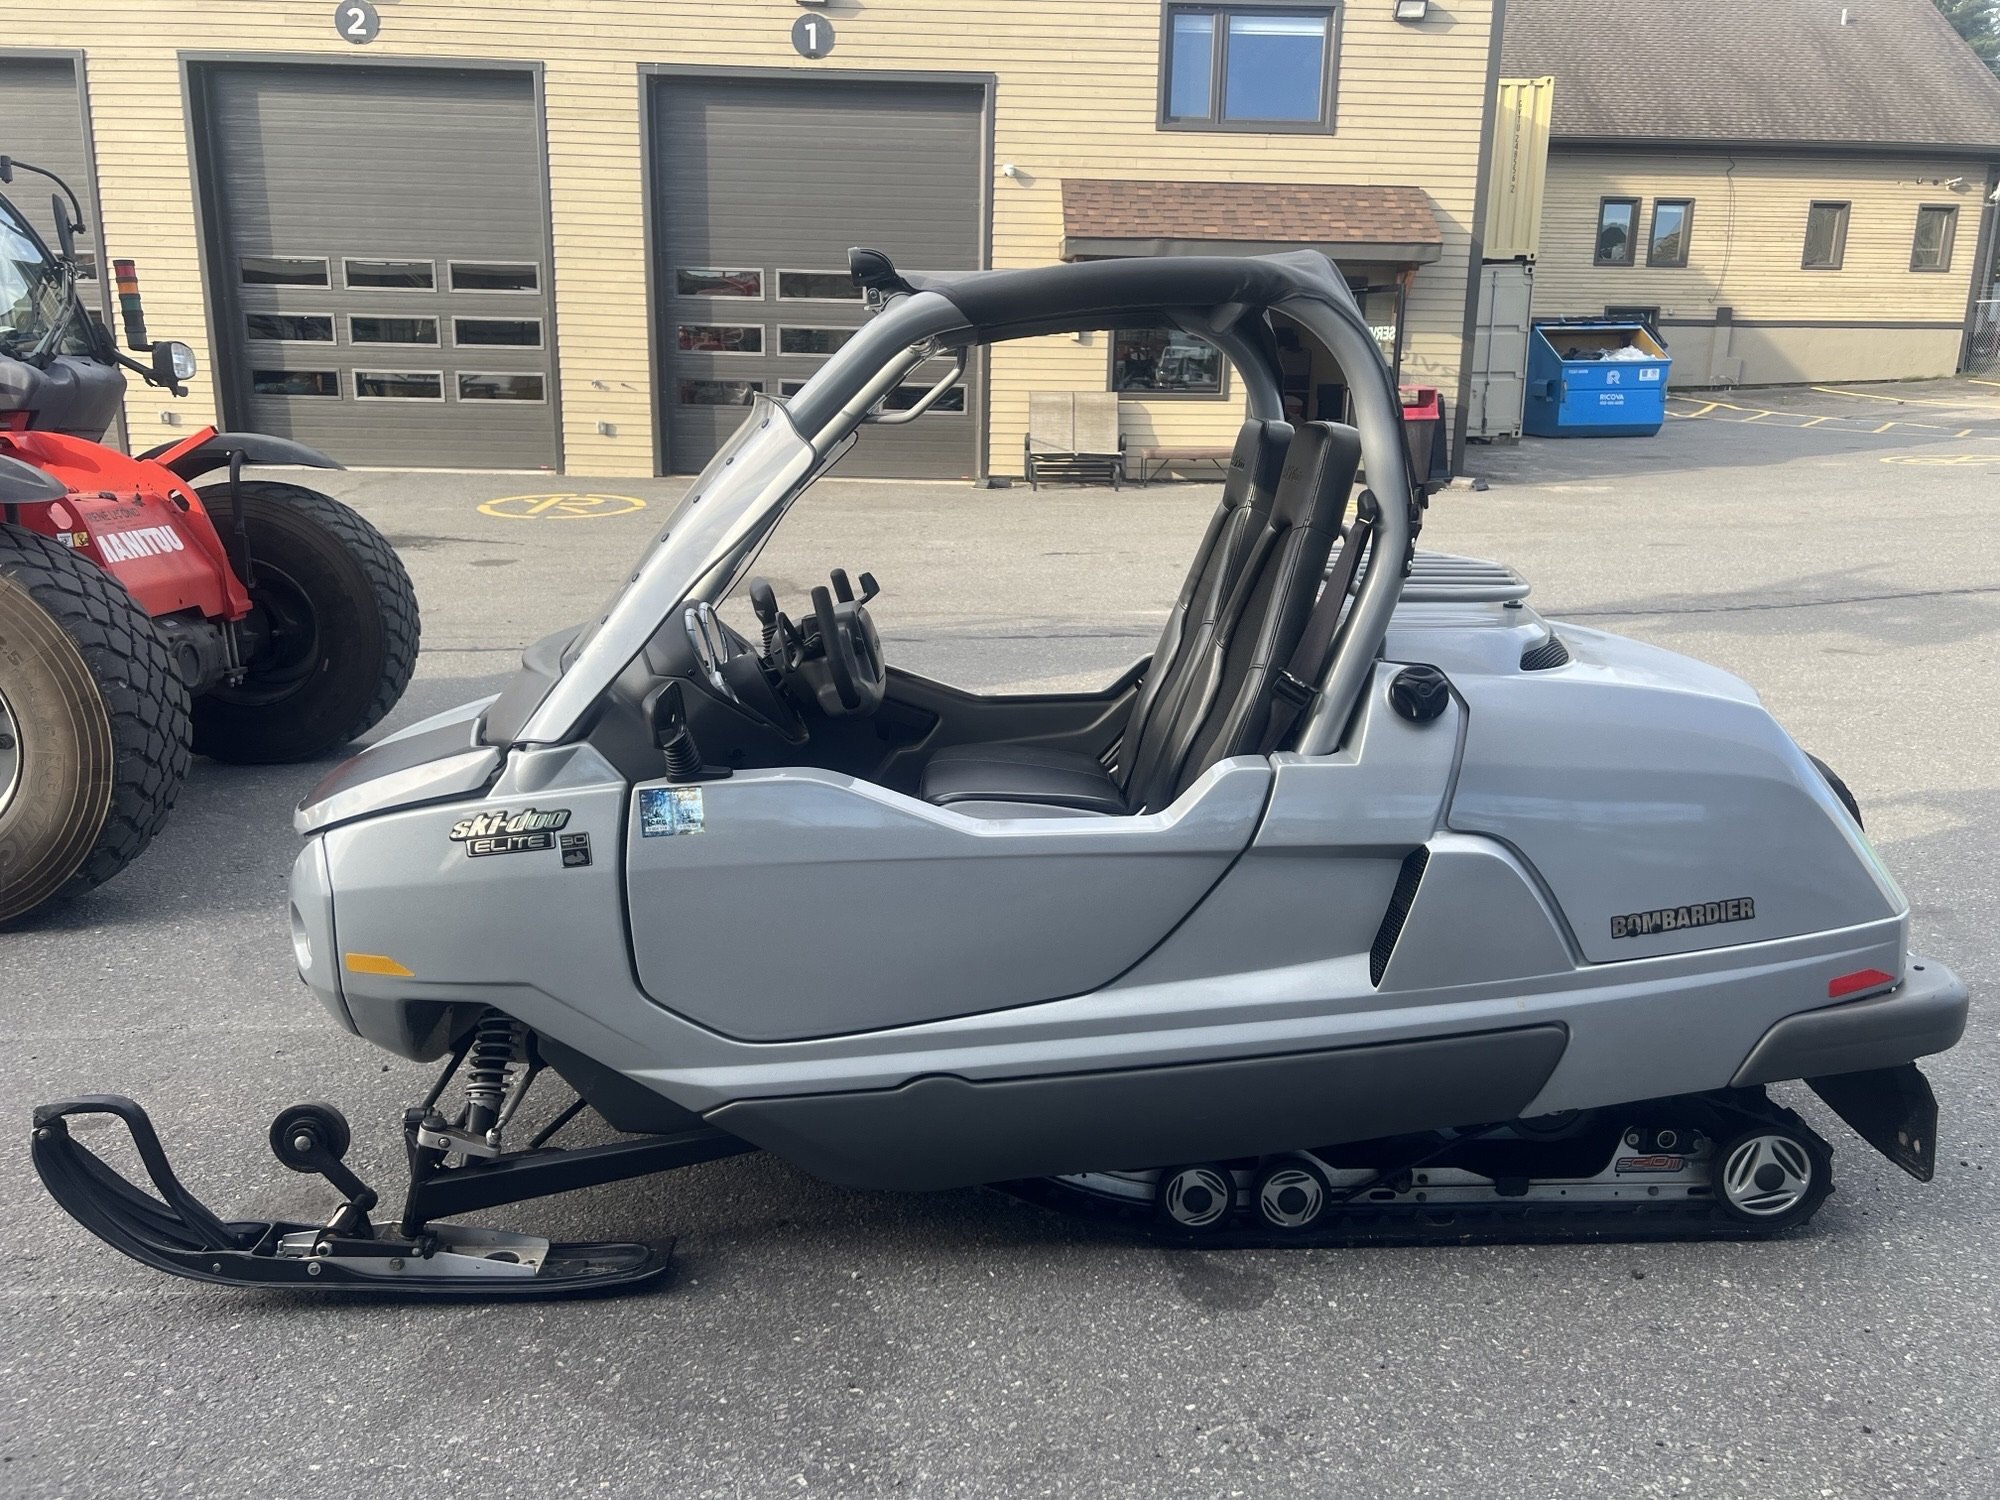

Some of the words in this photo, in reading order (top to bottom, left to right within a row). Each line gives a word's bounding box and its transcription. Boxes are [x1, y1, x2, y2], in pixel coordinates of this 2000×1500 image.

[347, 7, 367, 35] 2
[804, 22, 817, 50] 1
[474, 834, 546, 853] ELITE
[1612, 898, 1754, 938] BOMBARDIER
